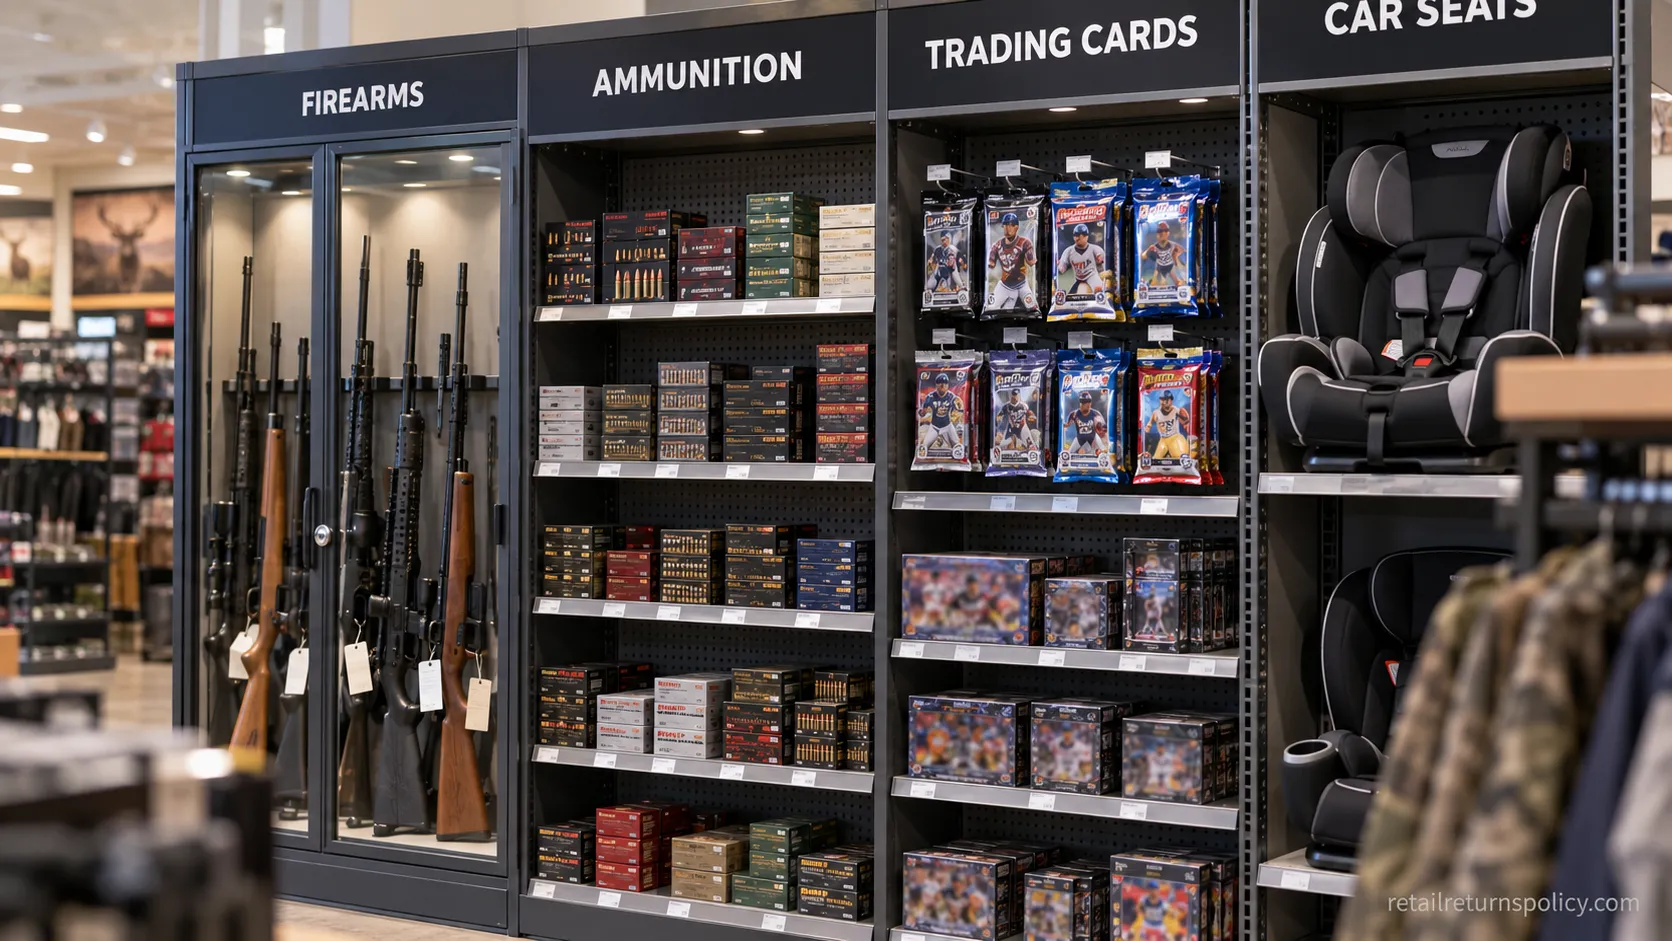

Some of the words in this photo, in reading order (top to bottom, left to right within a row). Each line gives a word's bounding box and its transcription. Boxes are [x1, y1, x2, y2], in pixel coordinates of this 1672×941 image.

[1324, 0, 1404, 36] CAR
[924, 26, 1071, 70] TRADING
[1081, 14, 1198, 56] CARDS
[592, 50, 802, 98] AMMUNITION
[301, 80, 424, 117] FIREARMS
